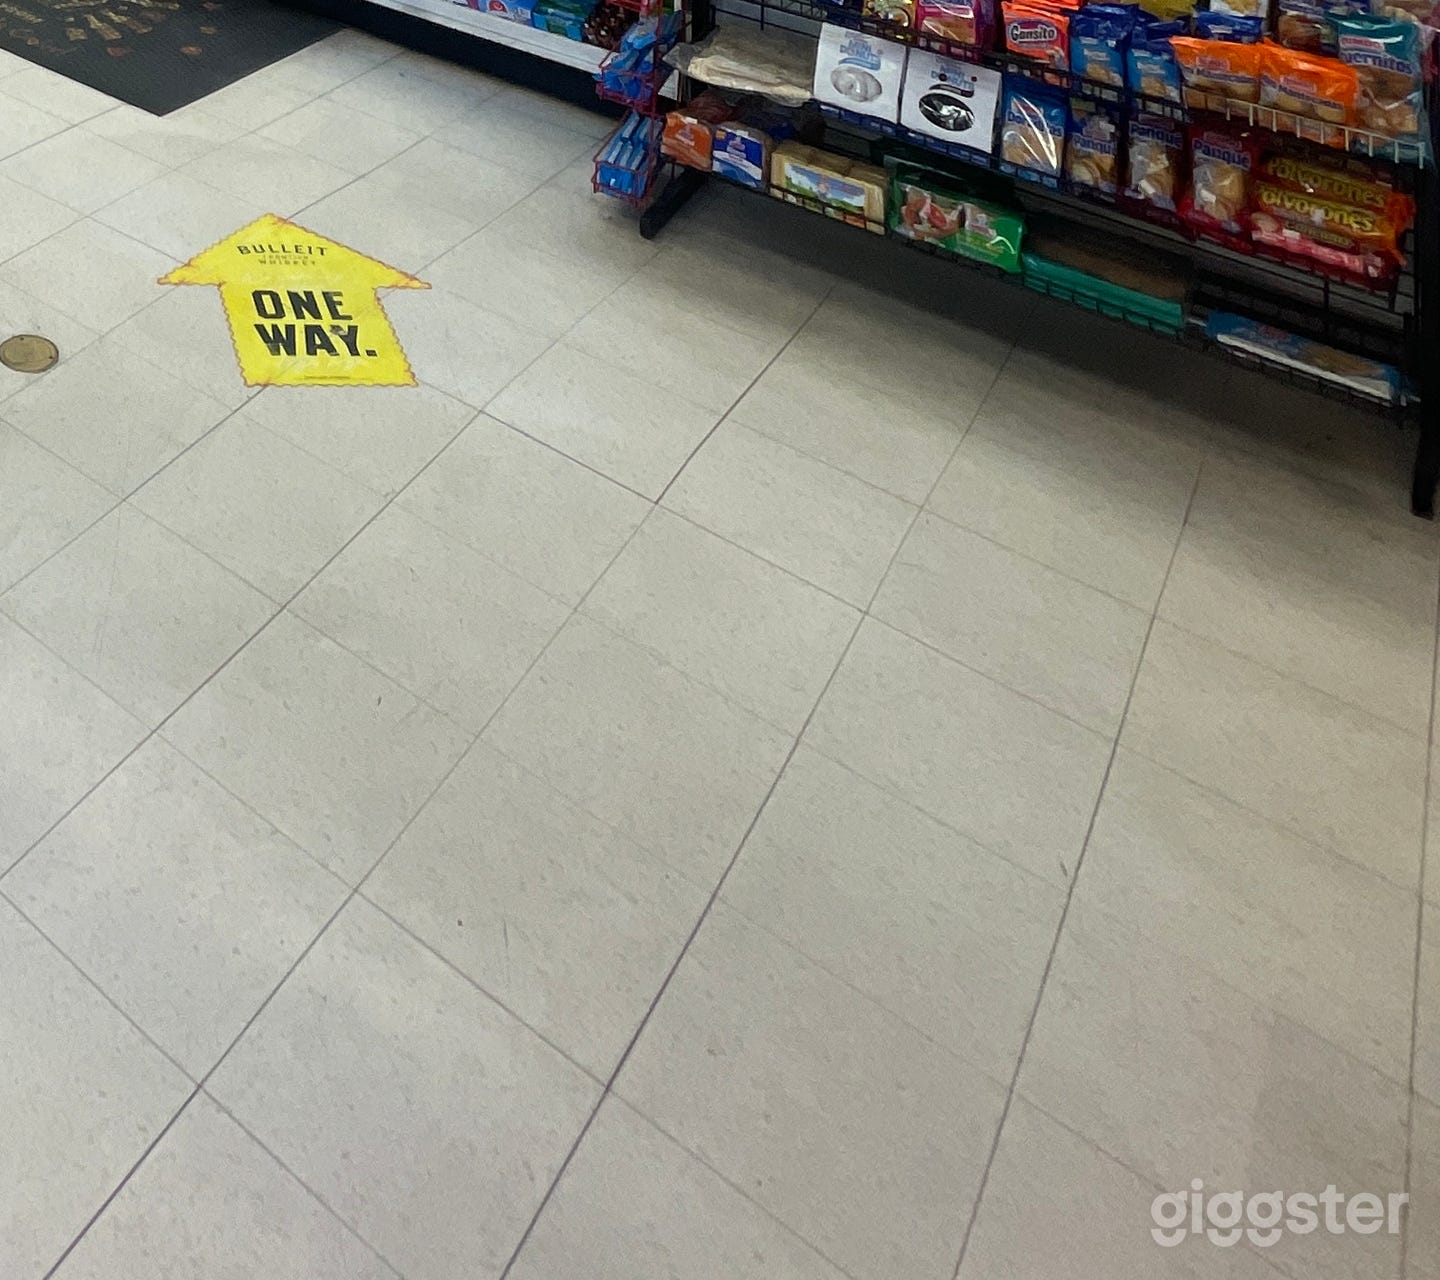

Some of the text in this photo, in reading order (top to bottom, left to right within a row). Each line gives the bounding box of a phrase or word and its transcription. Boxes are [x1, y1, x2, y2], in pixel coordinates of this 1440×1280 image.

[1010, 25, 1057, 42] Gansito
[1344, 52, 1413, 75] uernitos
[1261, 189, 1375, 232] olvorones
[236, 244, 327, 257] BULLEIT
[252, 289, 353, 321] ONE
[254, 324, 378, 357] WAY.
